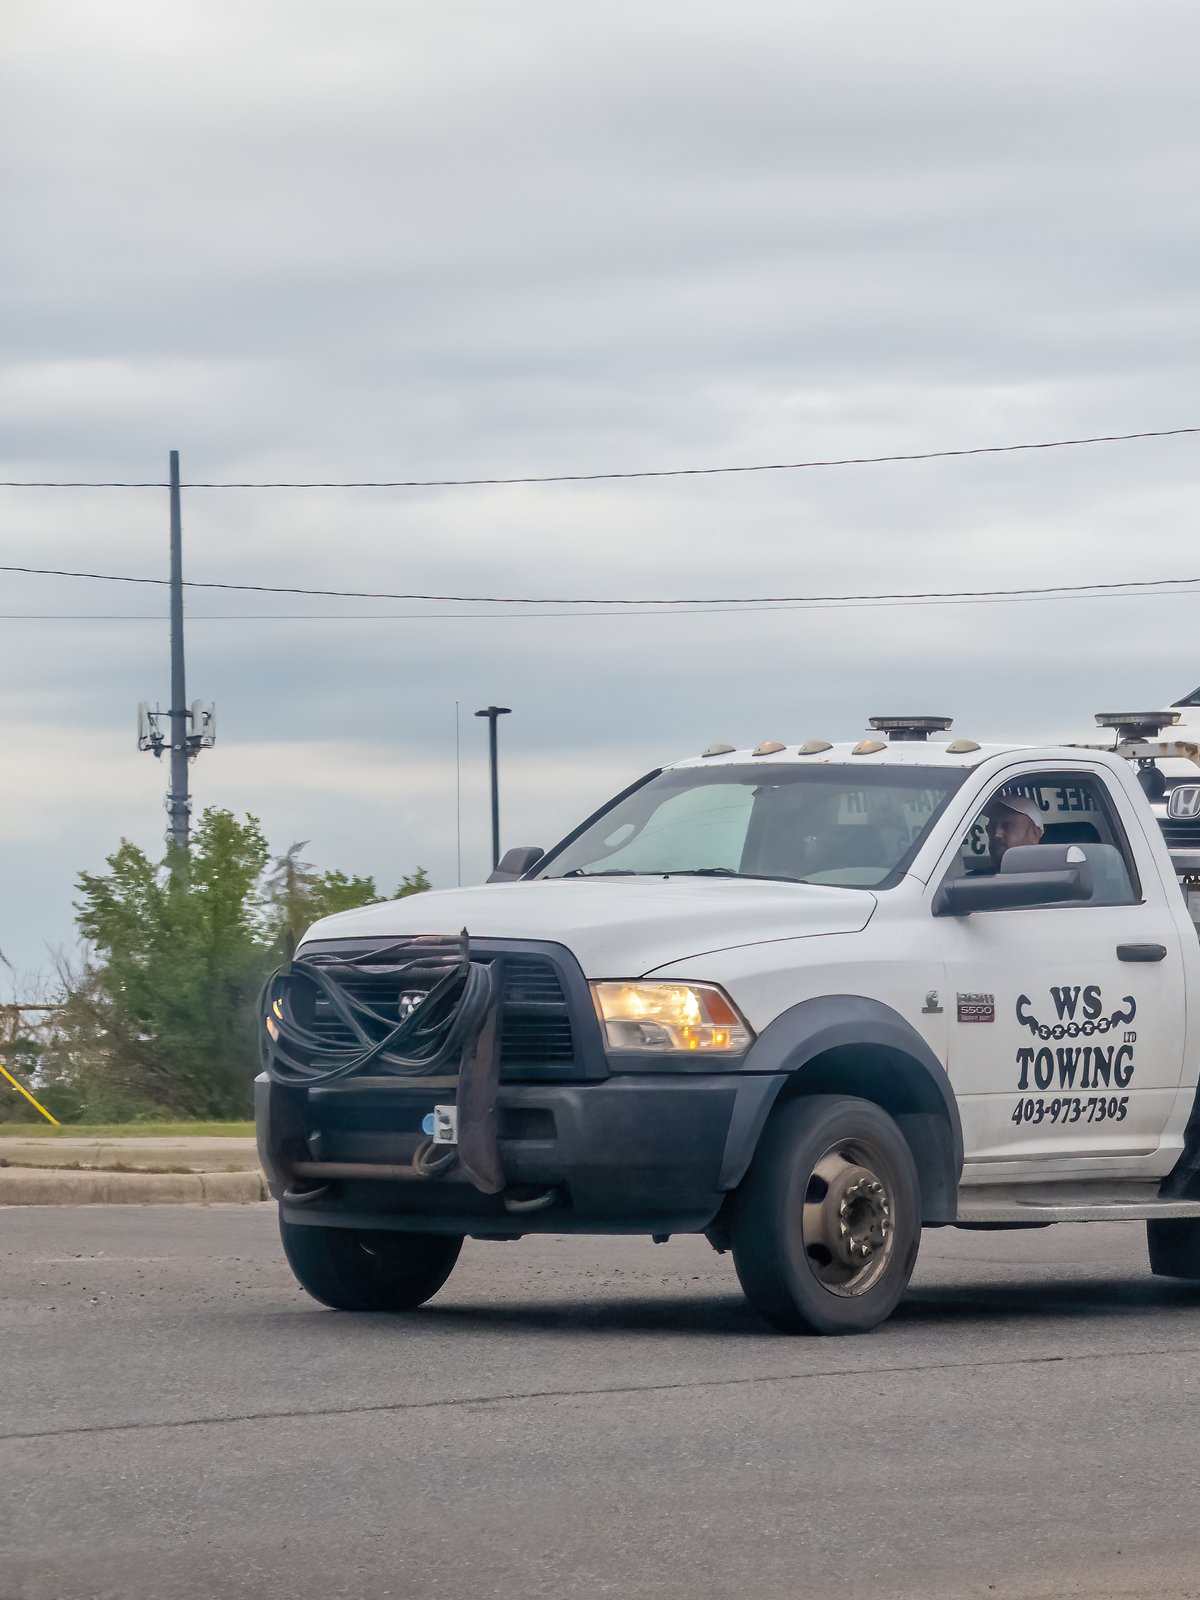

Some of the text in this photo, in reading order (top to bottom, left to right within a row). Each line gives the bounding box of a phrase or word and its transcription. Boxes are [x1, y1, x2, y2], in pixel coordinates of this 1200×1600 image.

[961, 1006, 992, 1014] 5500
[1050, 985, 1102, 1020] WS
[1123, 1031, 1137, 1043] LTD
[1016, 1045, 1135, 1090] TOWING
[1011, 1096, 1129, 1125] 403-973-7305
